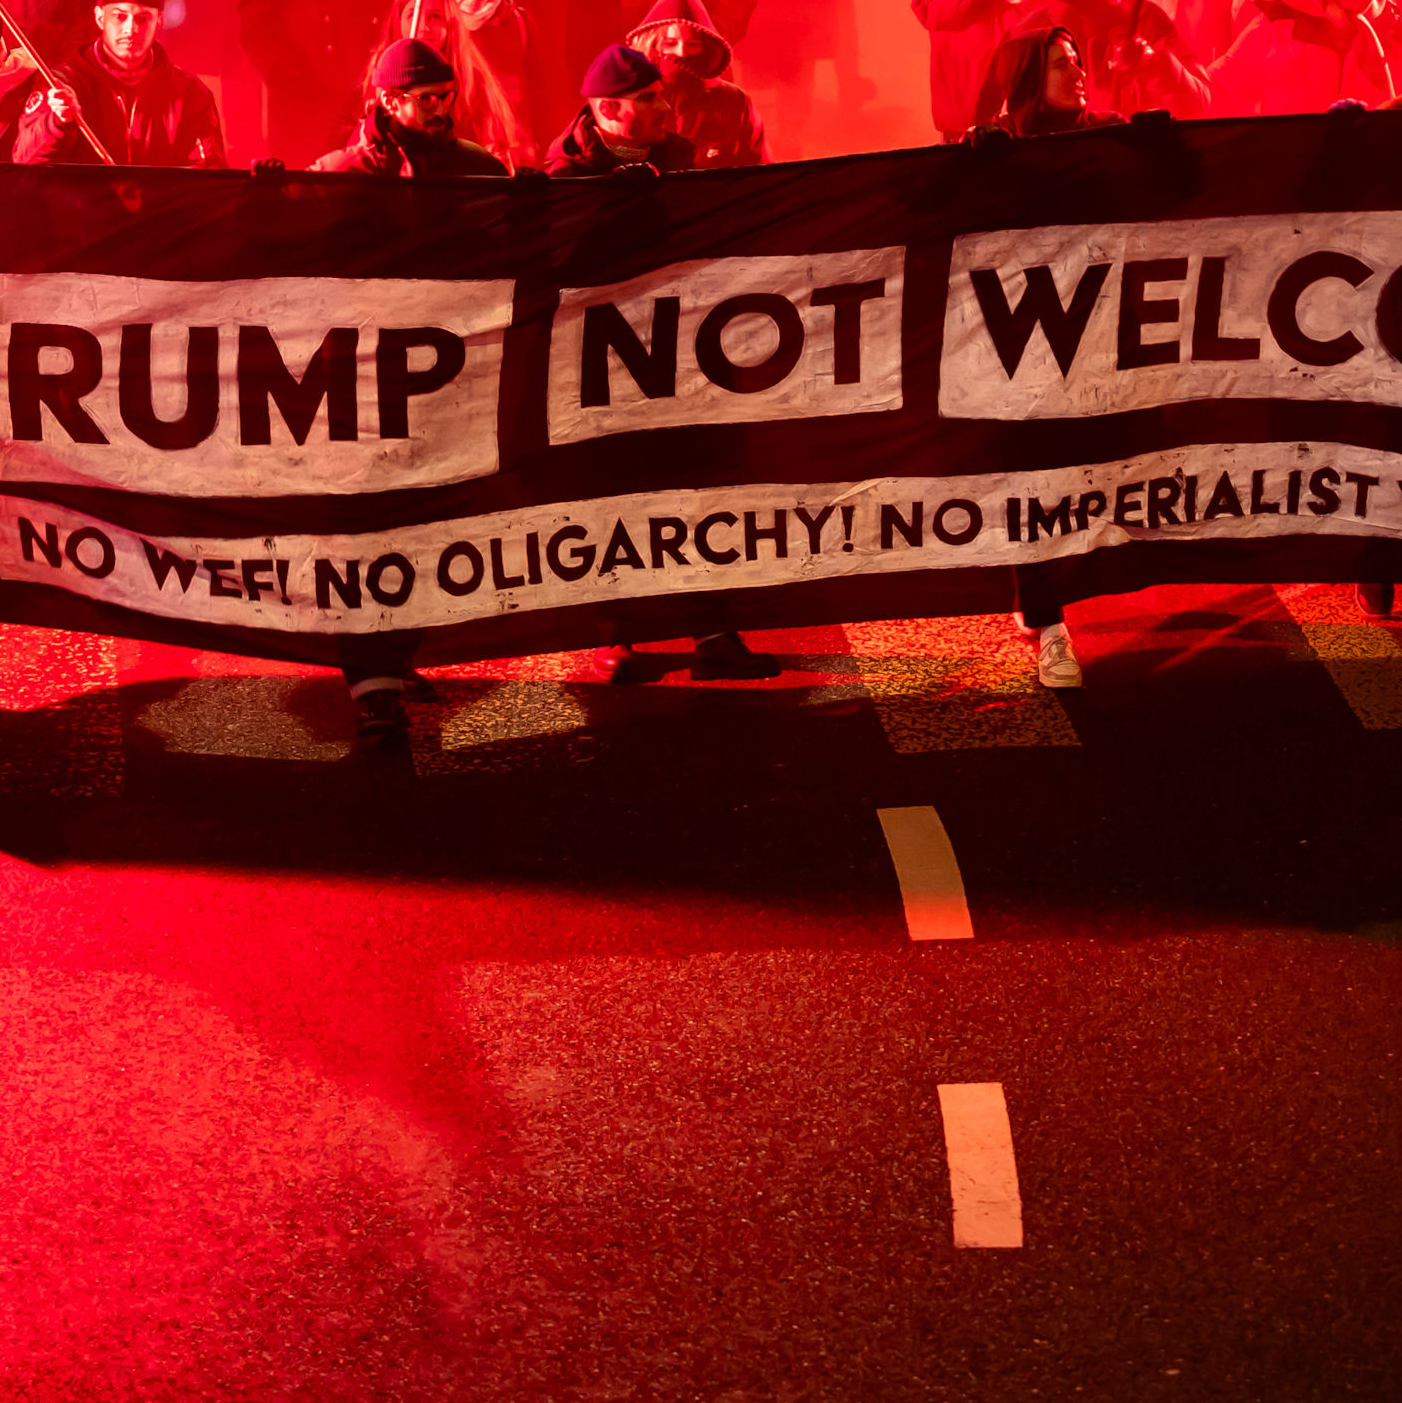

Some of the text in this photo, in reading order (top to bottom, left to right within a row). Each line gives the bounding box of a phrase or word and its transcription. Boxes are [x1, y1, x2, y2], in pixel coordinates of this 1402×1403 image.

[579, 277, 887, 408] NOT
[17, 516, 117, 580] NO
[139, 536, 293, 606] WEF!
[314, 552, 417, 610] NO
[436, 504, 855, 597] OLIGARCHY!
[879, 497, 984, 550] NO
[1006, 466, 1381, 544] IMPERIALIST
